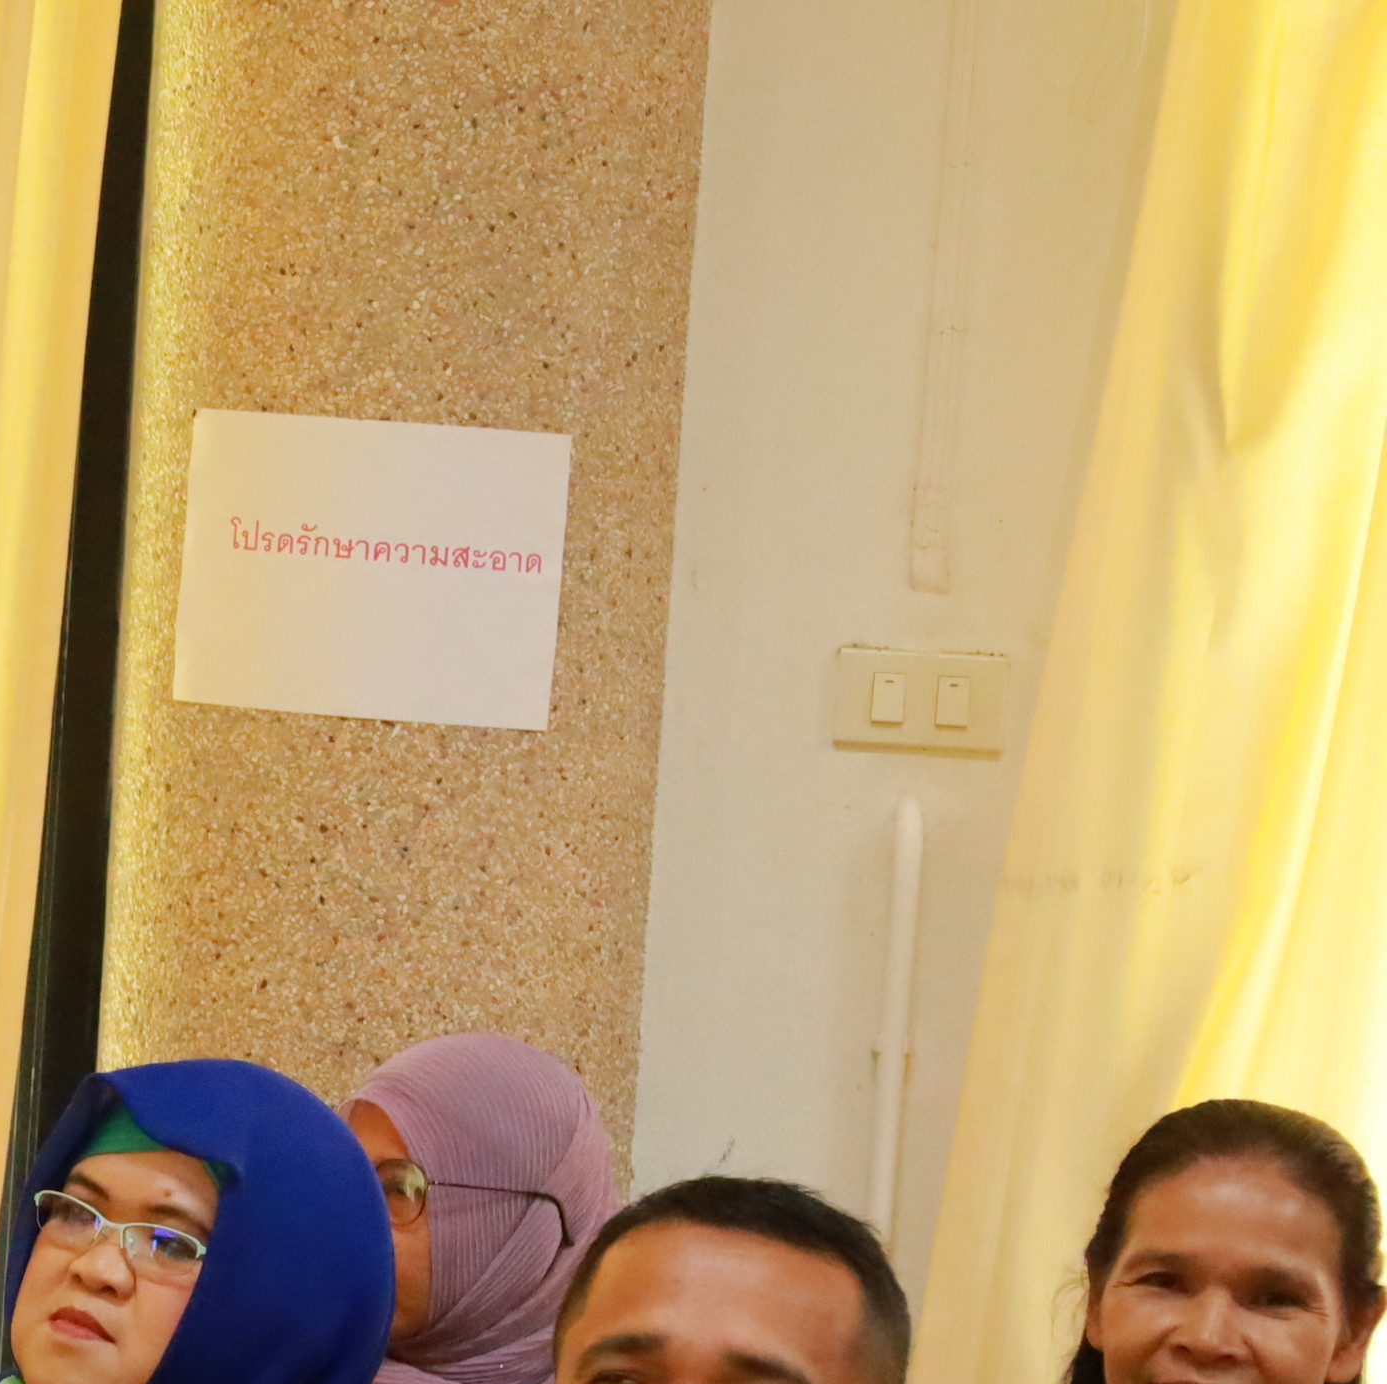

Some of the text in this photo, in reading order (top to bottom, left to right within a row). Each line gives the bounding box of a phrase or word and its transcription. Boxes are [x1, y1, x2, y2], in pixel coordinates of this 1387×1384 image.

[230, 515, 543, 574] โปรดรักษาความสะอาด
